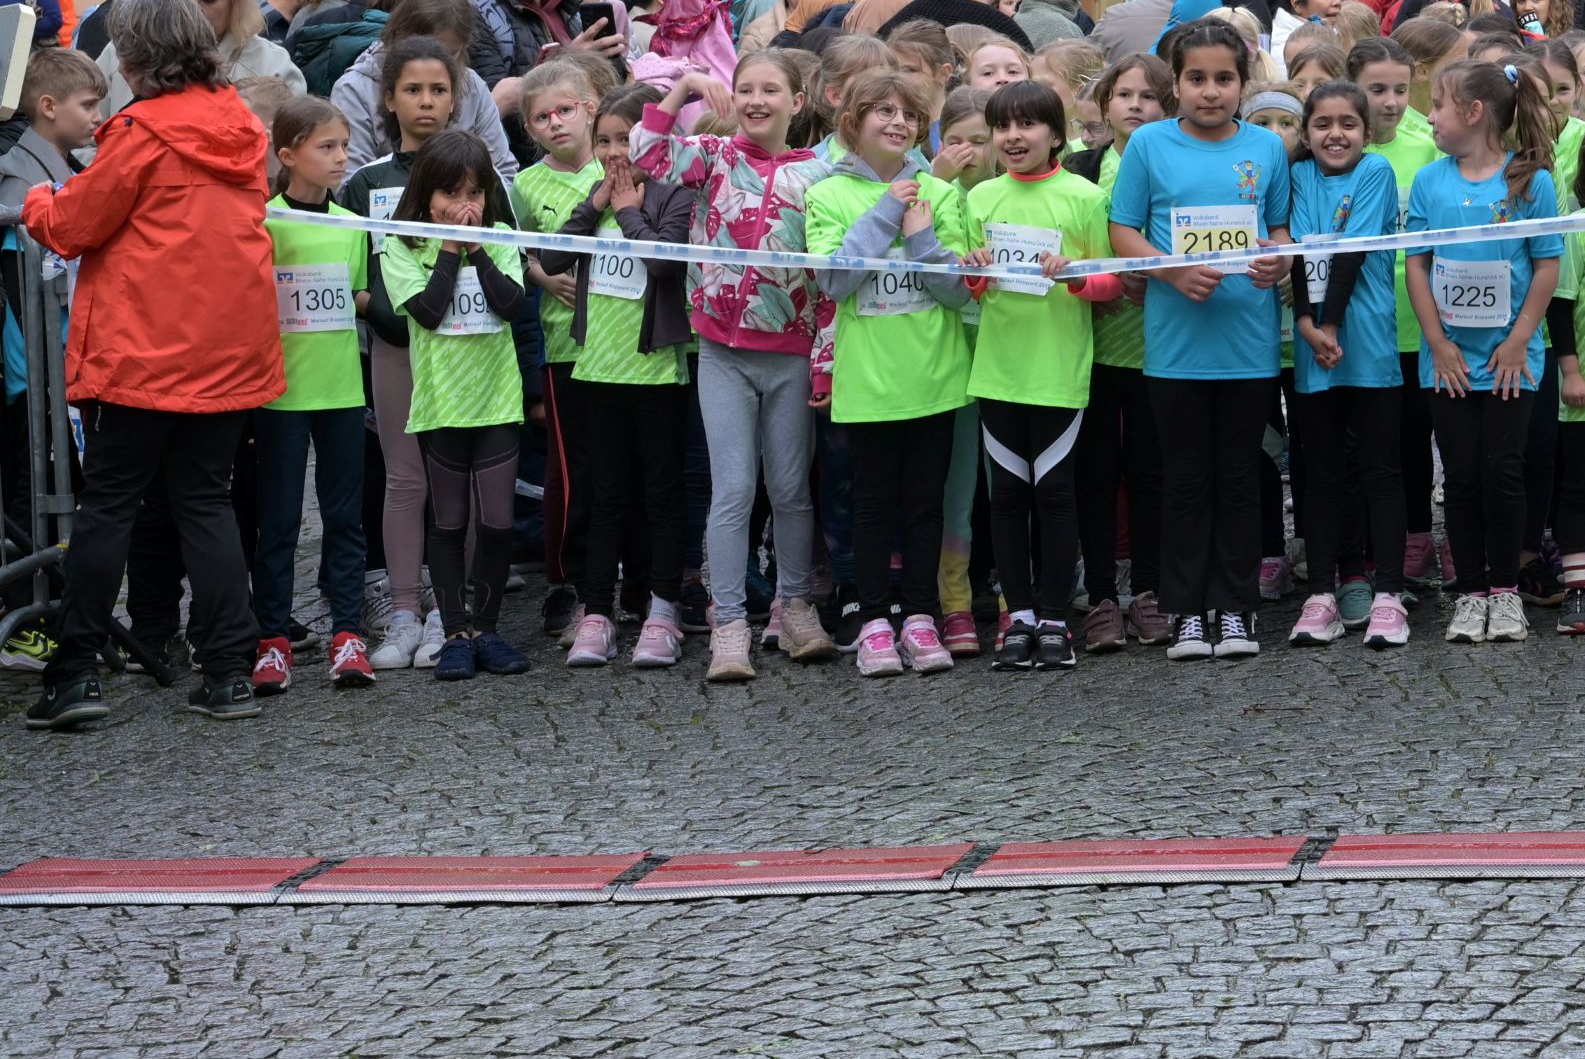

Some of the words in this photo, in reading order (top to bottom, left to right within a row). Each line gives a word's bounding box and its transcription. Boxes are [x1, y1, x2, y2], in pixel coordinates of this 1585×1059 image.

[1184, 230, 1248, 254] 2189
[290, 288, 346, 311] 1305
[451, 292, 490, 316] 109
[1442, 283, 1496, 307] 1225
